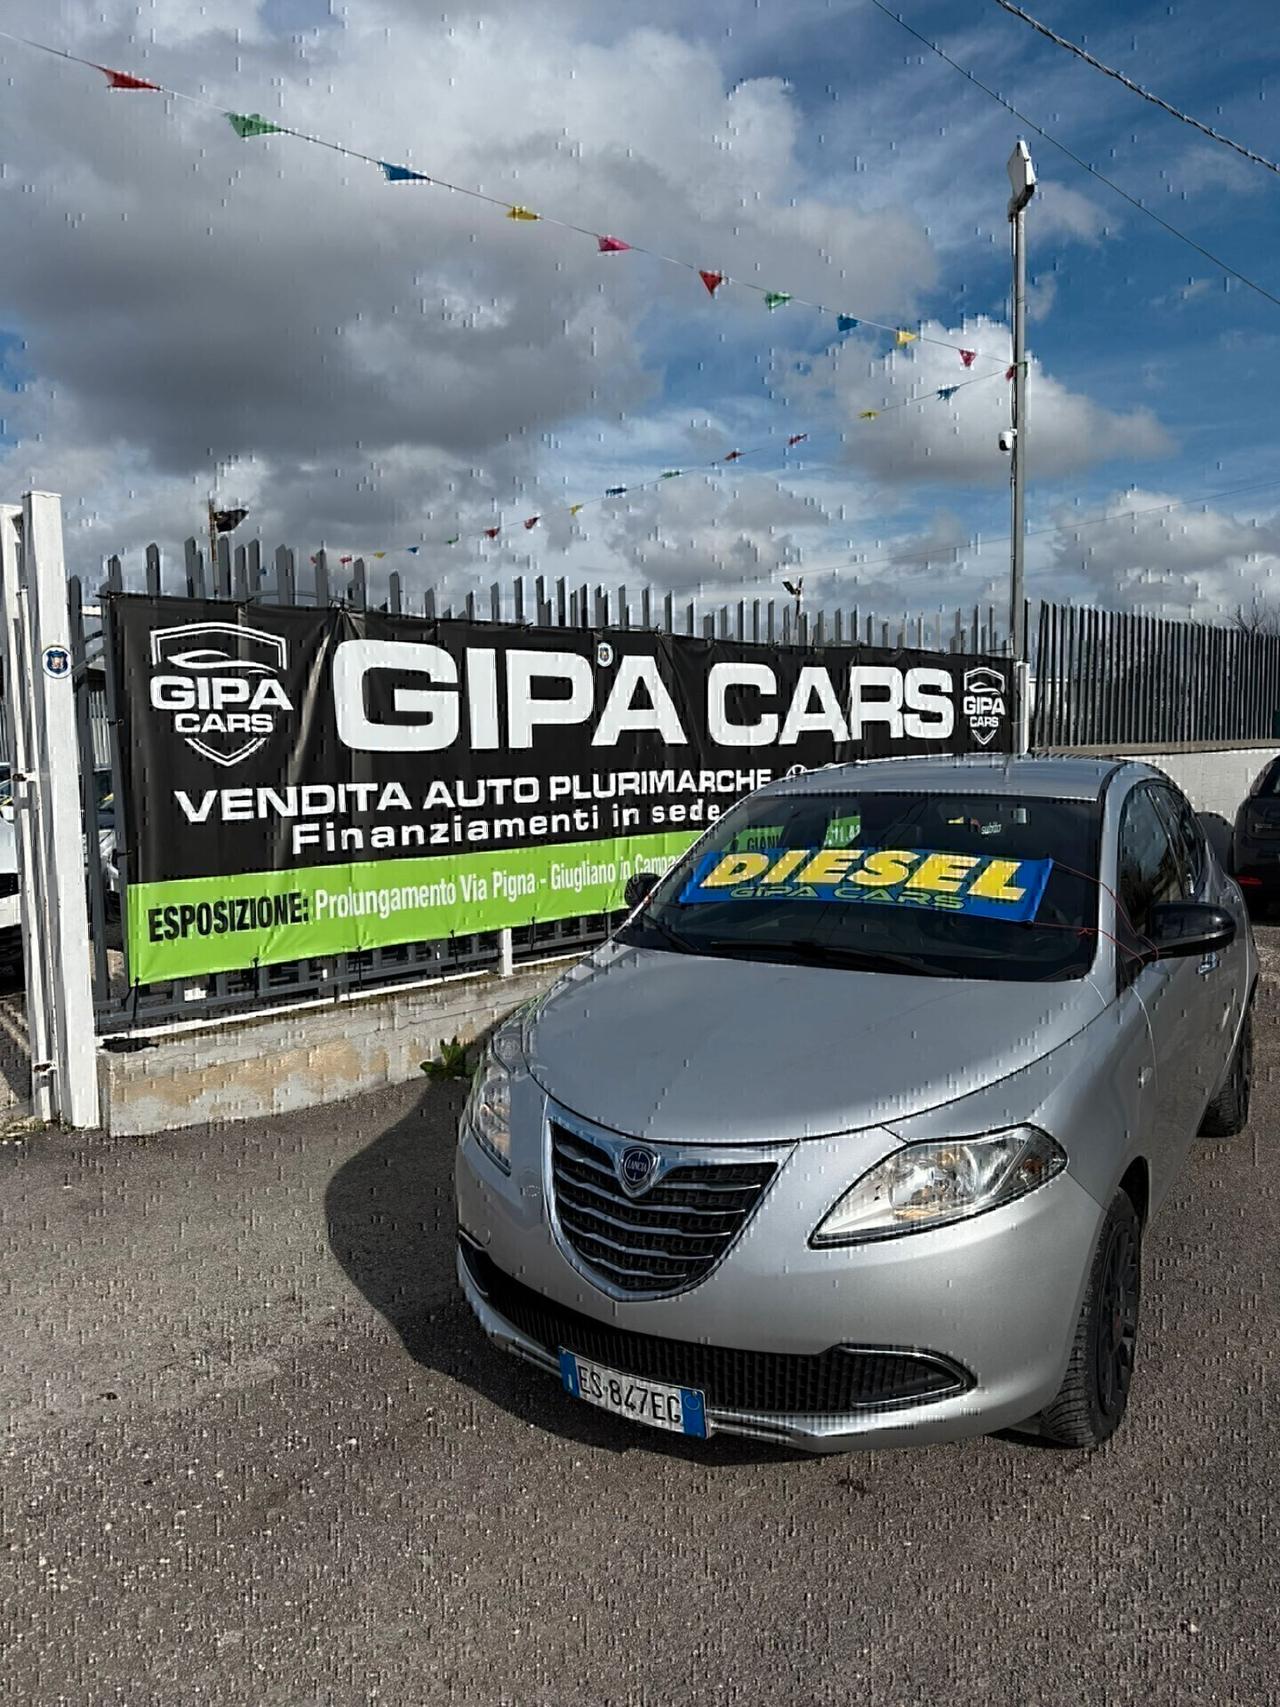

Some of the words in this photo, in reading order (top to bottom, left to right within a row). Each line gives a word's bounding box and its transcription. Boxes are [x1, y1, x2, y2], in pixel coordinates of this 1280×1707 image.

[149, 675, 294, 711] GIPA
[332, 639, 688, 752] GIPA
[707, 662, 954, 746] CARS
[963, 695, 1006, 715] GIPA
[174, 713, 274, 733] CARS
[969, 716, 999, 727] CARS
[174, 782, 413, 823] VENDITA
[422, 776, 540, 809] AUTO
[549, 768, 772, 801] PLURIMARCHE
[291, 805, 599, 855] Finanziamenti
[612, 803, 640, 828] in
[652, 799, 721, 823] sede
[700, 849, 1027, 901] DIESEL
[147, 892, 309, 943] ESPOSIZIONE:
[315, 876, 458, 921] Prolungamento
[459, 873, 488, 900] Via
[491, 868, 537, 903] Pigna
[550, 860, 617, 896] Giugliano
[619, 857, 633, 879] in
[635, 853, 685, 878] Campa
[729, 884, 820, 899] GIPA
[833, 885, 966, 911] CARS
[577, 1365, 603, 1399] ES
